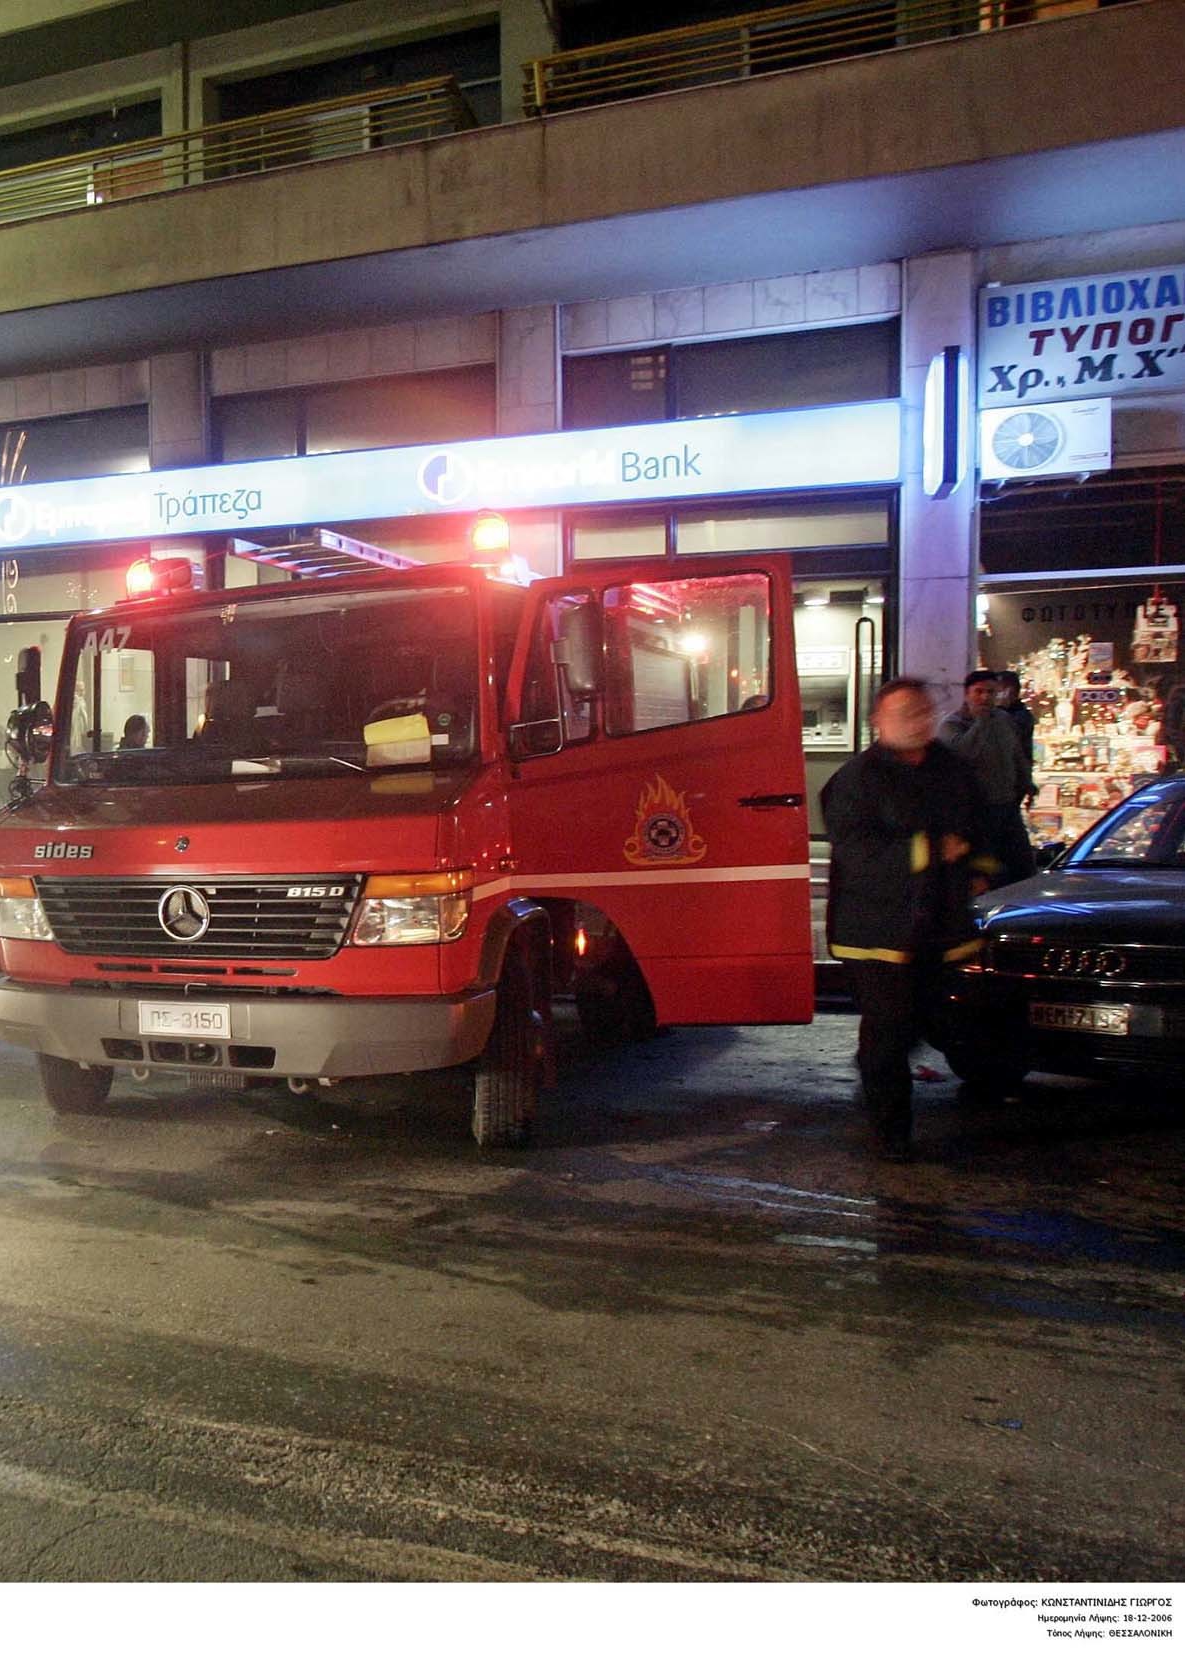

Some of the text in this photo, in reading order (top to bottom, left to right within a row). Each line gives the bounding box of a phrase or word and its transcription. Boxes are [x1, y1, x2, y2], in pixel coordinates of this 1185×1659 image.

[987, 274, 1185, 328] ΒΙΒΛΙΟΧΑ
[620, 444, 702, 482] Bank
[154, 486, 262, 524] Τράπεζα
[33, 842, 92, 858] sides
[286, 886, 326, 898] 815
[150, 1010, 223, 1029] ΠΣ-3150
